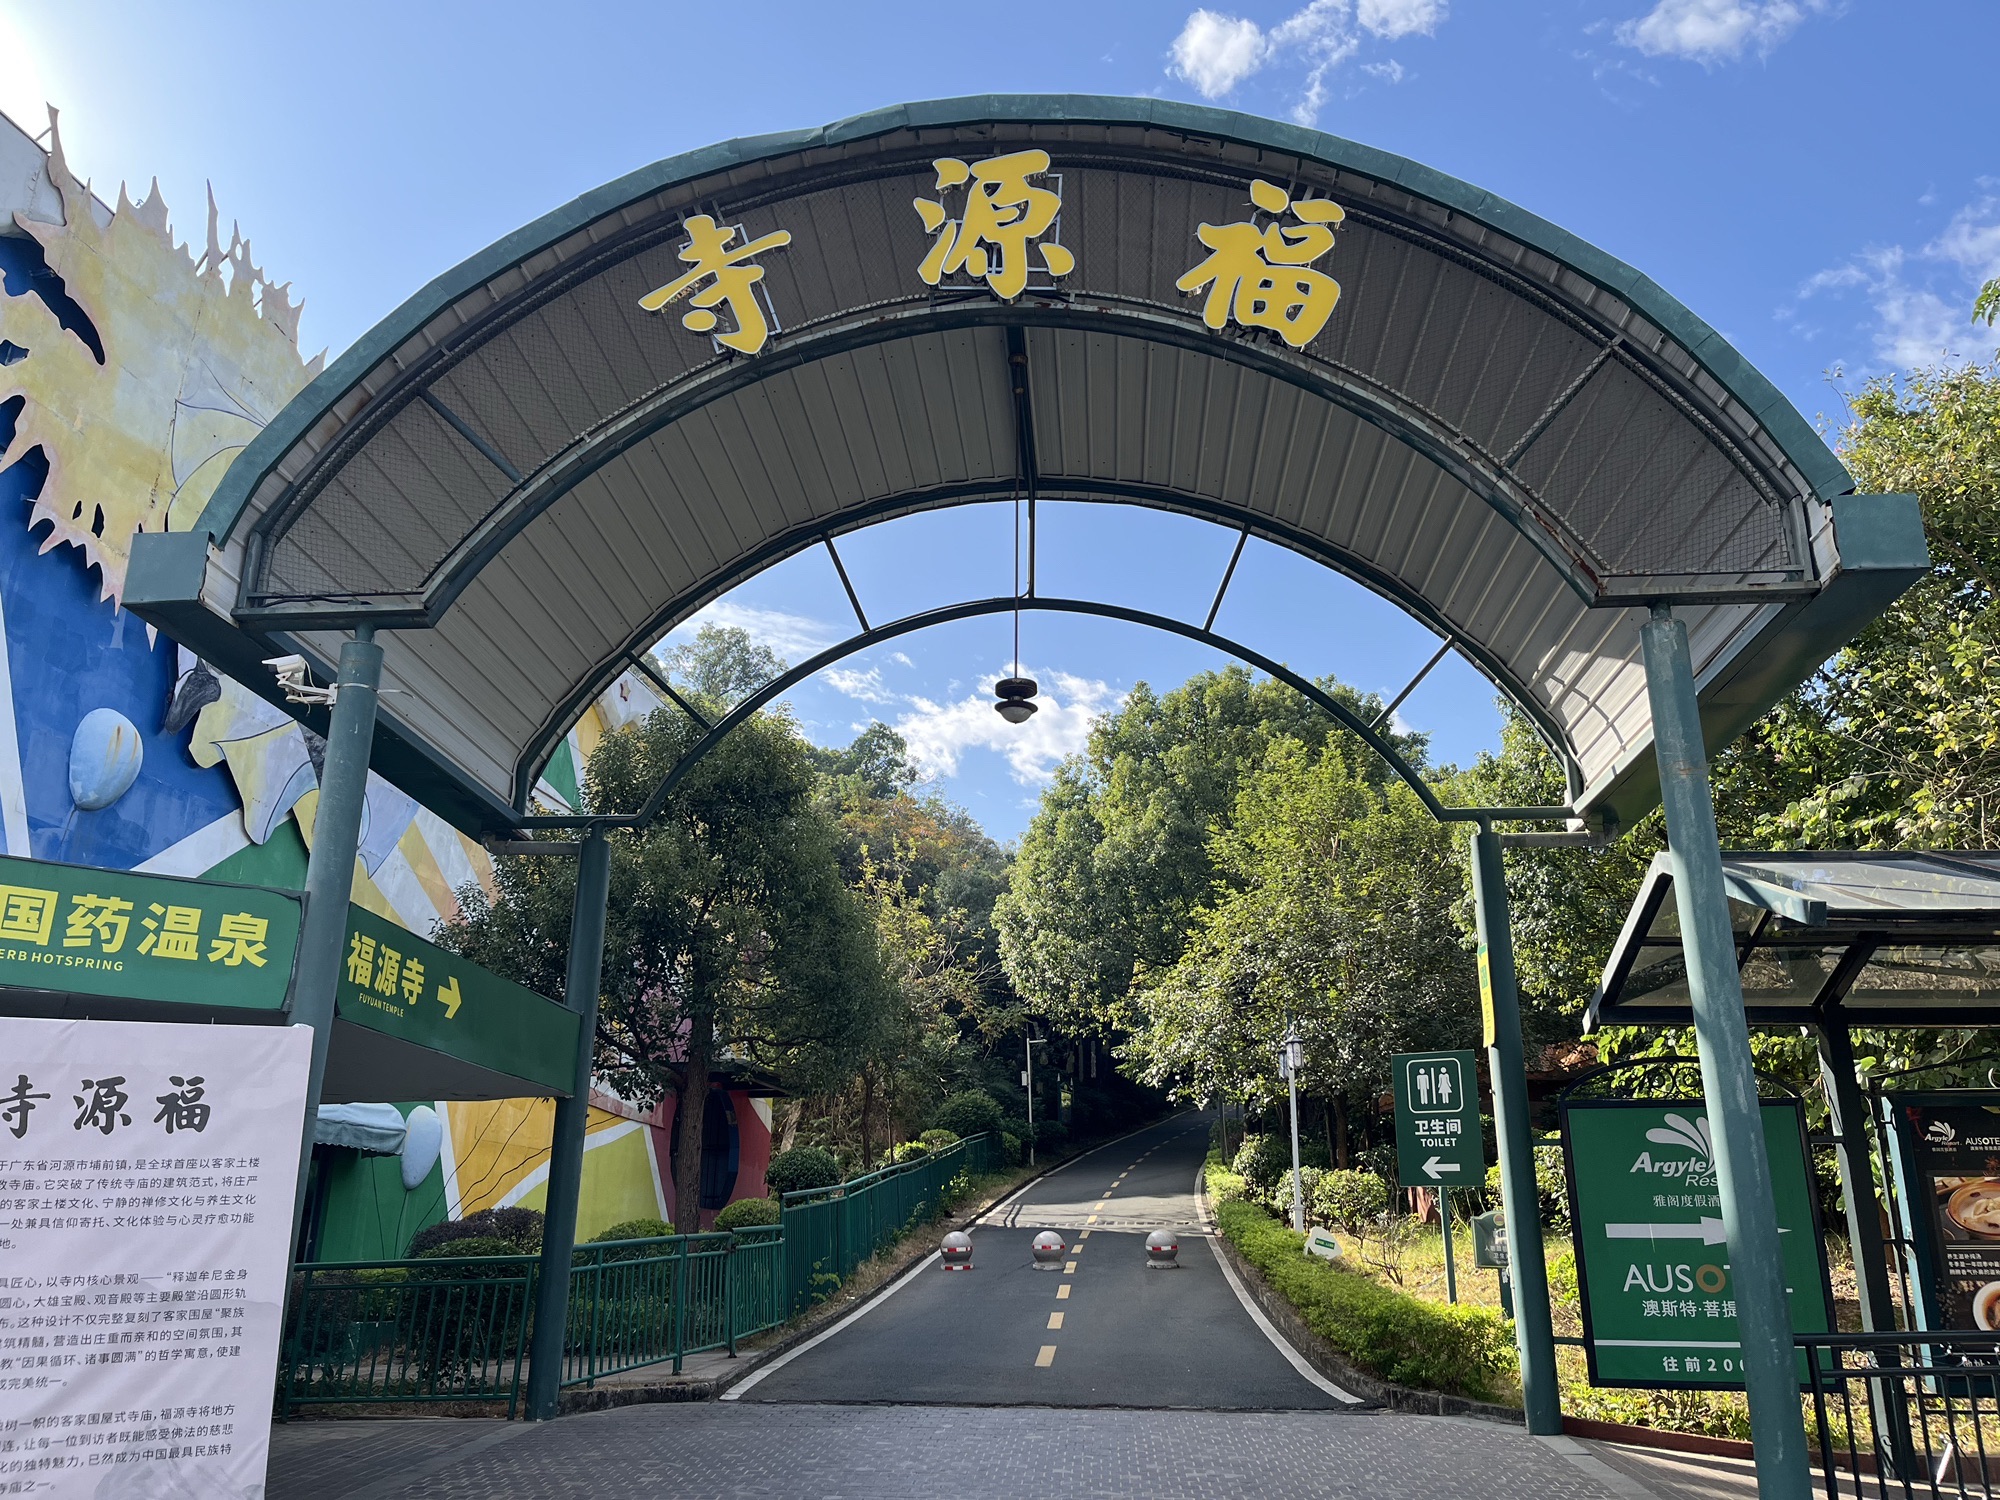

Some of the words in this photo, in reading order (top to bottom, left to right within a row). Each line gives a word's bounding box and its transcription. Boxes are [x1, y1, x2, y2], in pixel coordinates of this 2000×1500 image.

[0, 884, 269, 968] 国药温泉
[31, 952, 124, 971] HOTSPRING
[347, 931, 425, 1005] 福源寺
[359, 993, 382, 1009] FUYUAN
[382, 1001, 404, 1017] TEMPLE
[1415, 1119, 1462, 1135] 卫生间
[1925, 1133, 1949, 1142] Argyle
[1420, 1138, 1457, 1147] TOILET
[1630, 1151, 1707, 1177] Argyle
[1653, 1194, 1720, 1207] 雅阁度假酒
[1623, 1264, 1731, 1294] AUSO
[0, 1326, 242, 1349] 筑精髓，营造出庄重而亲和的空间氛围，其
[0, 1404, 235, 1431] 树一帜的客家围屋式寺庙，福源寺将地方
